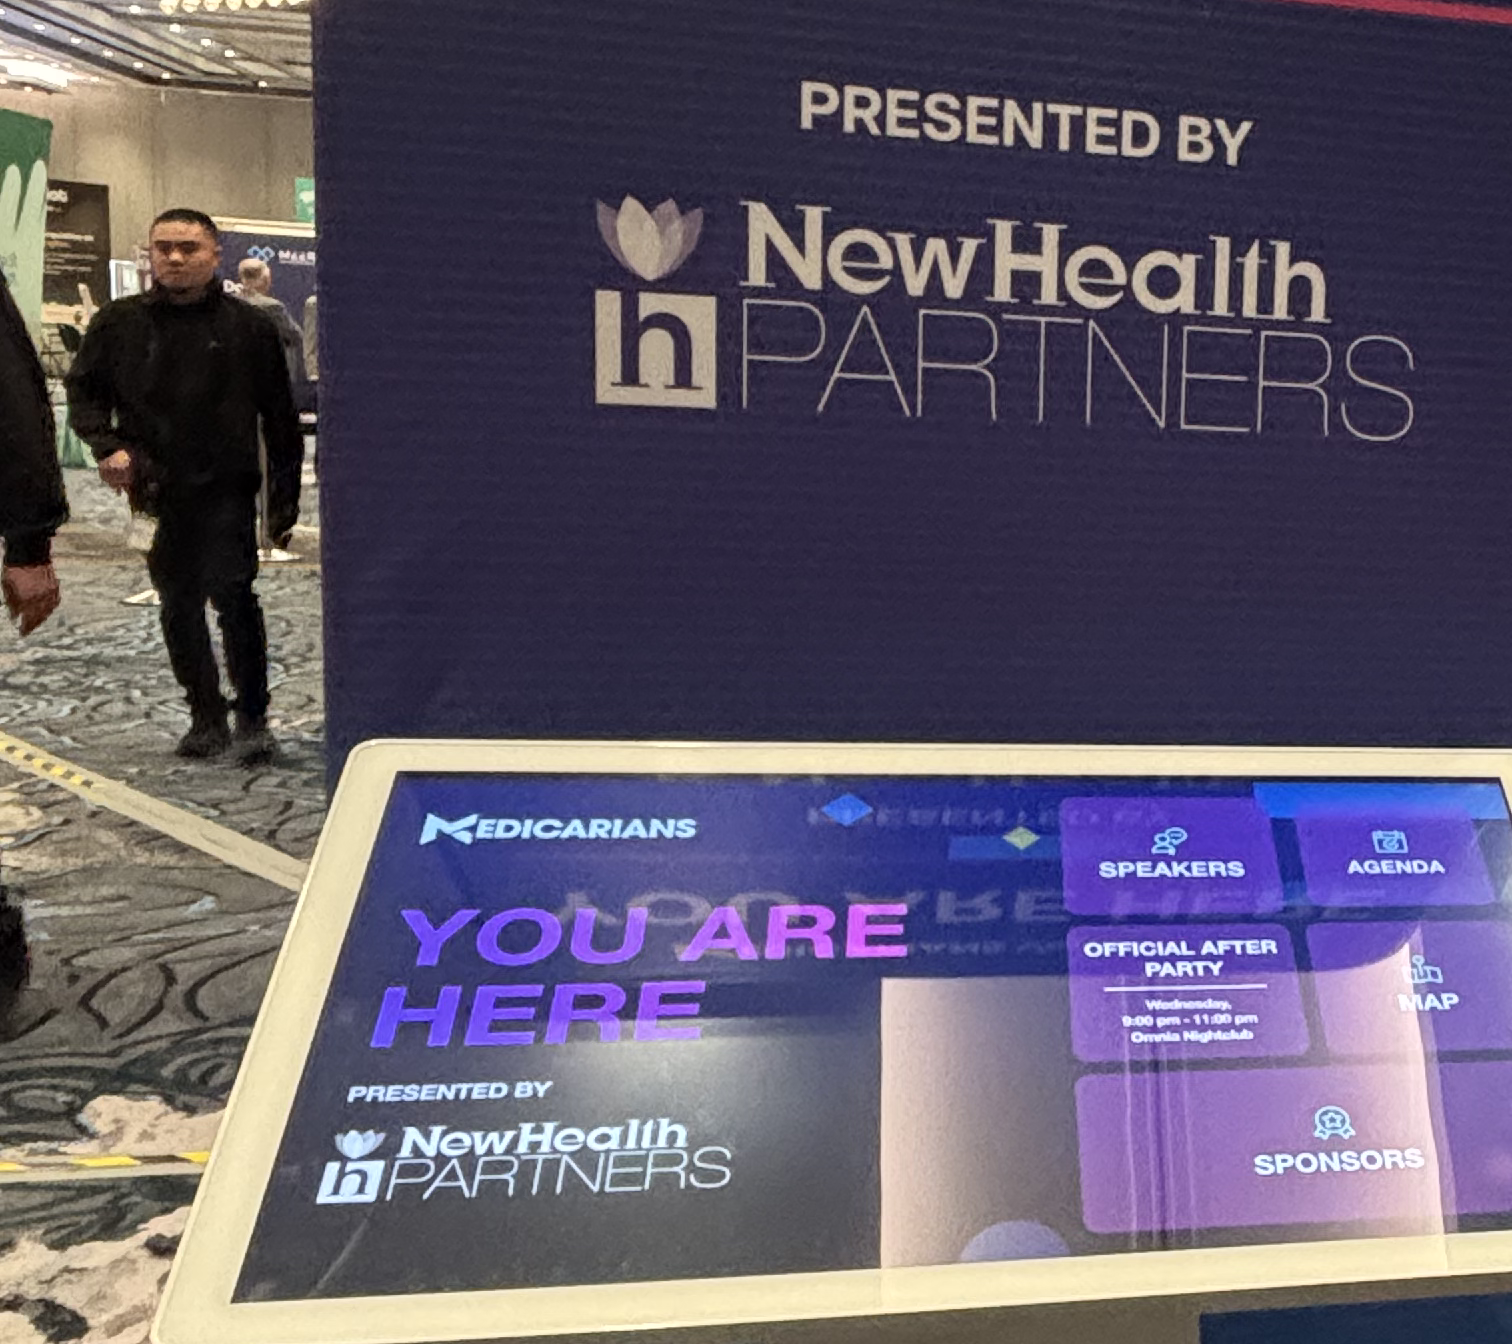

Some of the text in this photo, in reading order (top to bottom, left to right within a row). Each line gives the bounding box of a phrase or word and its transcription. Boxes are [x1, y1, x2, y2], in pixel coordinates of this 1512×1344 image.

[801, 81, 1253, 167] PRESENTED BY
[742, 298, 1415, 442] PARTNERS
[419, 813, 697, 846] MEDICARIANS
[1098, 860, 1245, 880] SPEAKERS
[1347, 860, 1446, 875] AGENDA
[400, 902, 908, 967] YOU ARE
[1083, 939, 1278, 957] OFFICIAL AFTER
[1145, 961, 1224, 977] PARTY
[1397, 992, 1459, 1012] MAP
[370, 980, 707, 1049] HERE
[1156, 1016, 1181, 1028] pm
[1193, 1014, 1232, 1025] 11:00
[1234, 1014, 1259, 1026] pm
[1183, 1029, 1254, 1043] Nightclub
[347, 1080, 553, 1103] PRESENTED BY
[385, 1146, 732, 1201] PARTNERS
[1253, 1148, 1425, 1177] SPONSORS
